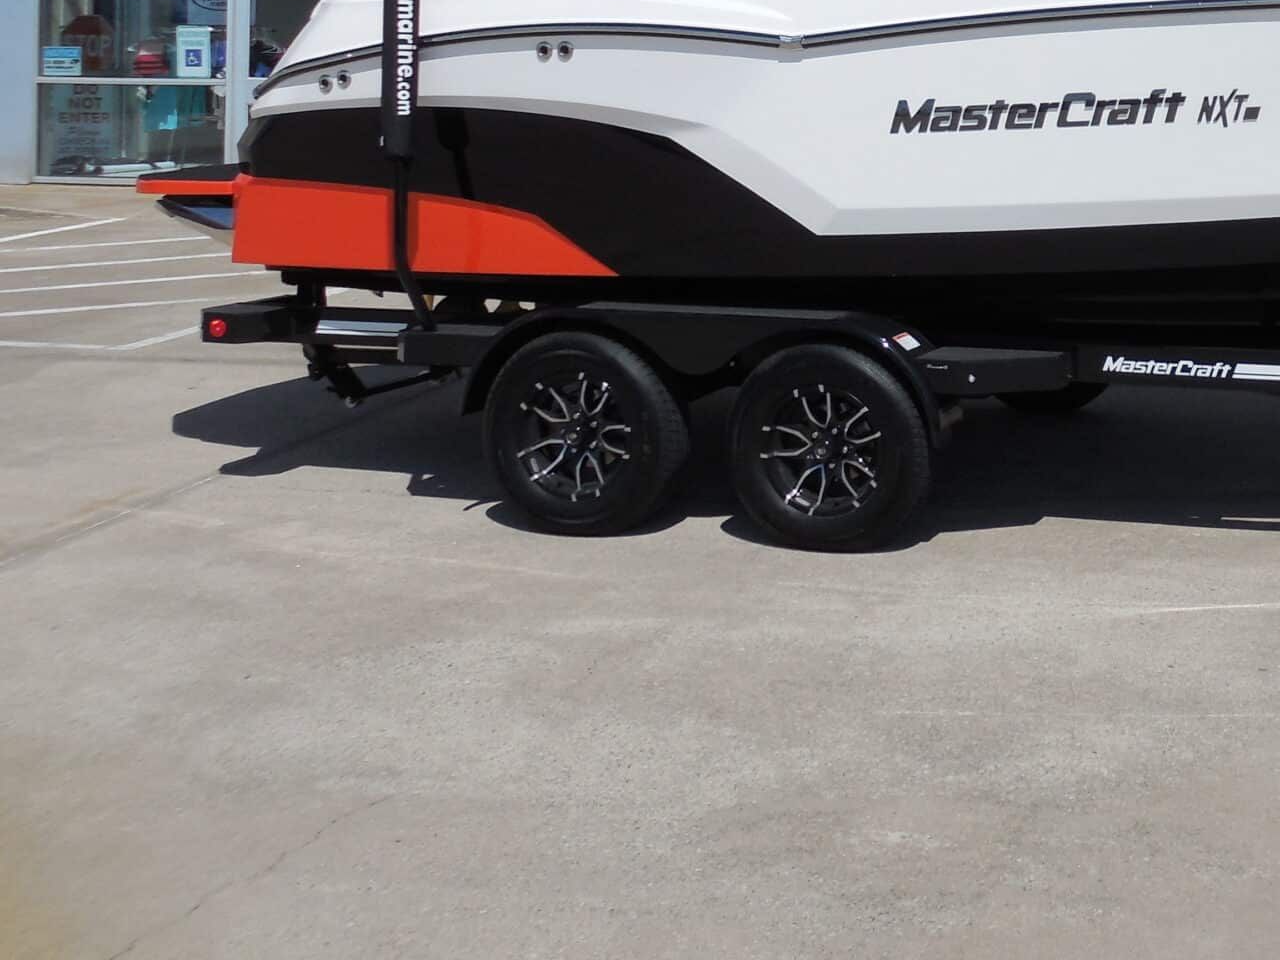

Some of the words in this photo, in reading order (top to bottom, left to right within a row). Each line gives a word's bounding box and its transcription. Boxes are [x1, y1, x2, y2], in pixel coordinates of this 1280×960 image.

[889, 88, 1187, 134] MasterCraft
[1197, 88, 1250, 128] NXT
[1102, 356, 1232, 379] MasterCraft
